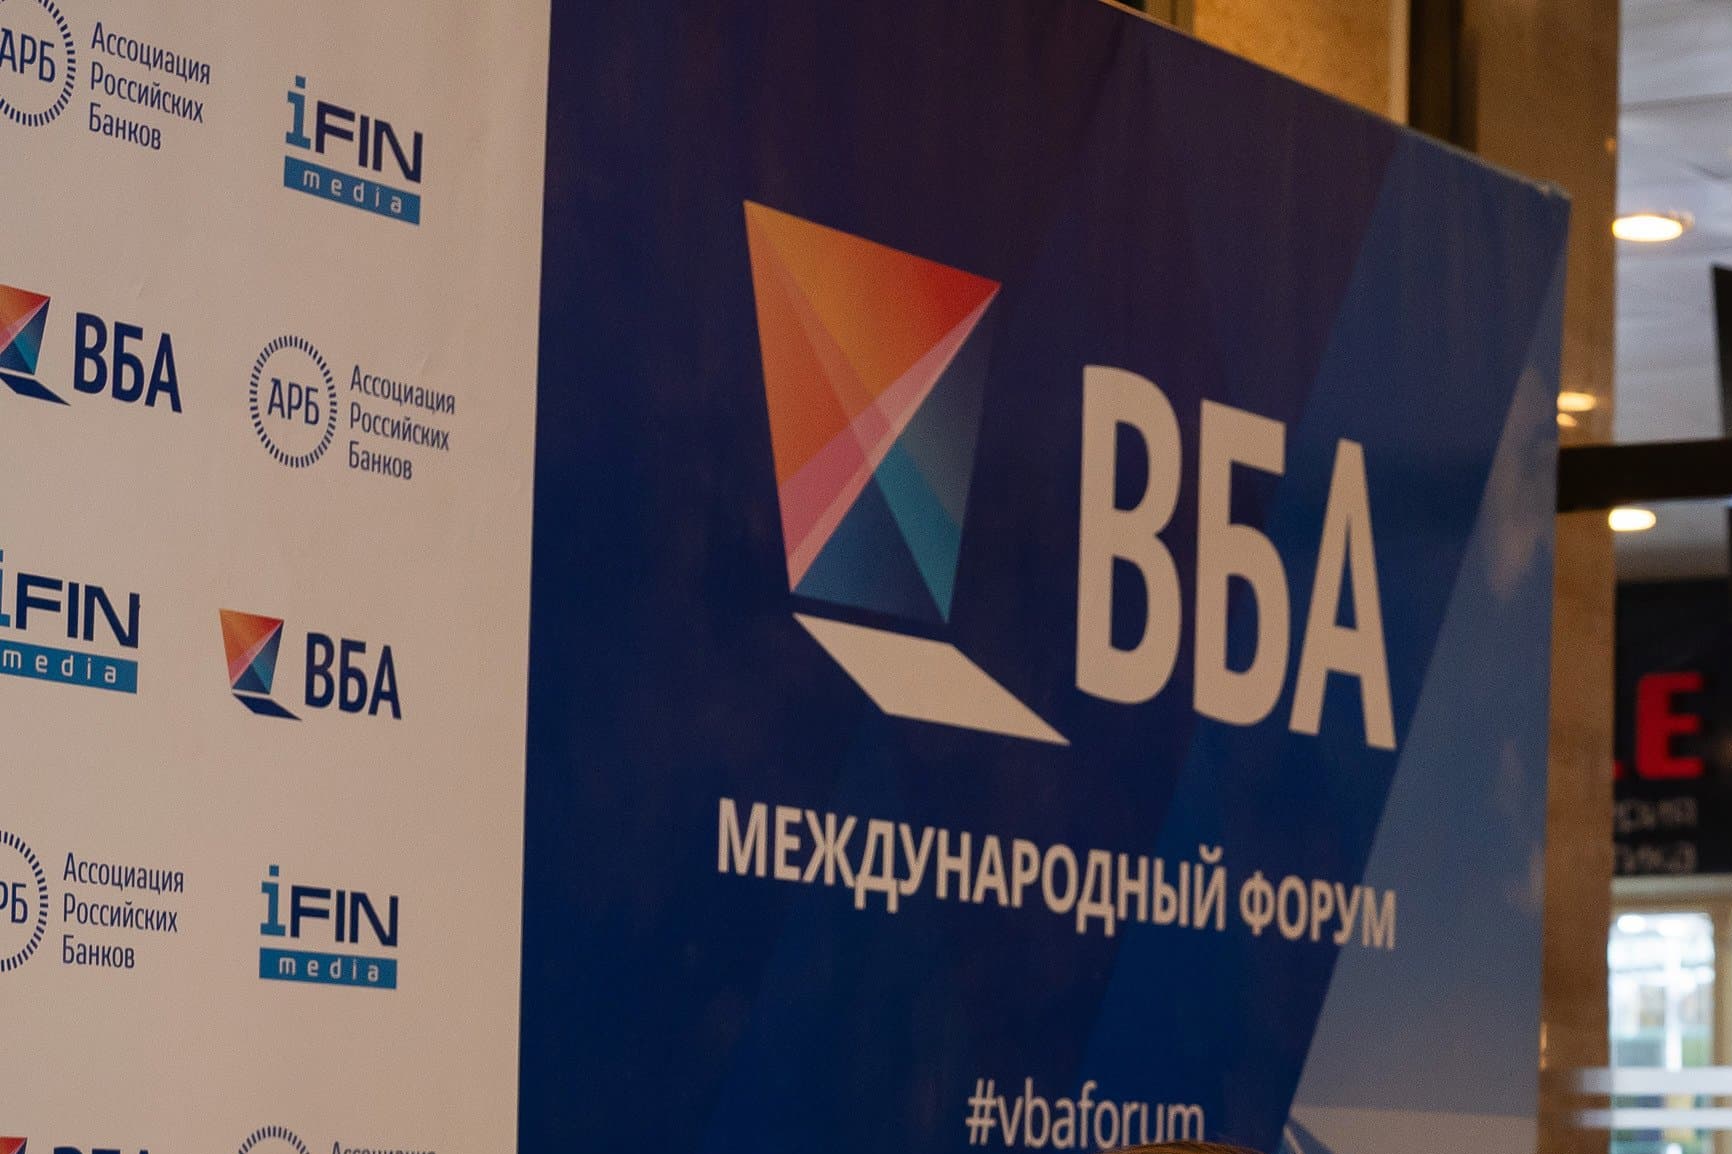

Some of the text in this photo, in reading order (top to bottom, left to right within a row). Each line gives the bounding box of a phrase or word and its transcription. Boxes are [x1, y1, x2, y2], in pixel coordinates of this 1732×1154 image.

[0, 27, 56, 84] АРБ
[91, 21, 211, 85] Ассоциация
[90, 61, 204, 124] Российских
[89, 102, 162, 150] Банков
[285, 75, 424, 184] iFIN
[303, 167, 403, 214] media
[74, 312, 183, 414] ВБА
[267, 377, 320, 426] АРБ
[350, 364, 456, 415] Ассоциация
[349, 401, 450, 451] Российских
[348, 440, 412, 480] Банков
[1075, 364, 1396, 751] ВБА
[3, 648, 117, 684] media
[304, 632, 402, 720] ВБА
[63, 852, 184, 894] Ассоциация
[717, 797, 1396, 950] МЕЖДУНАРОДНЫЙ ФОРУМ
[63, 892, 179, 933] Российских
[260, 865, 399, 947] iFIN
[62, 934, 135, 969] Банков
[278, 956, 379, 982] media
[965, 1077, 1205, 1150] #vbaforum
